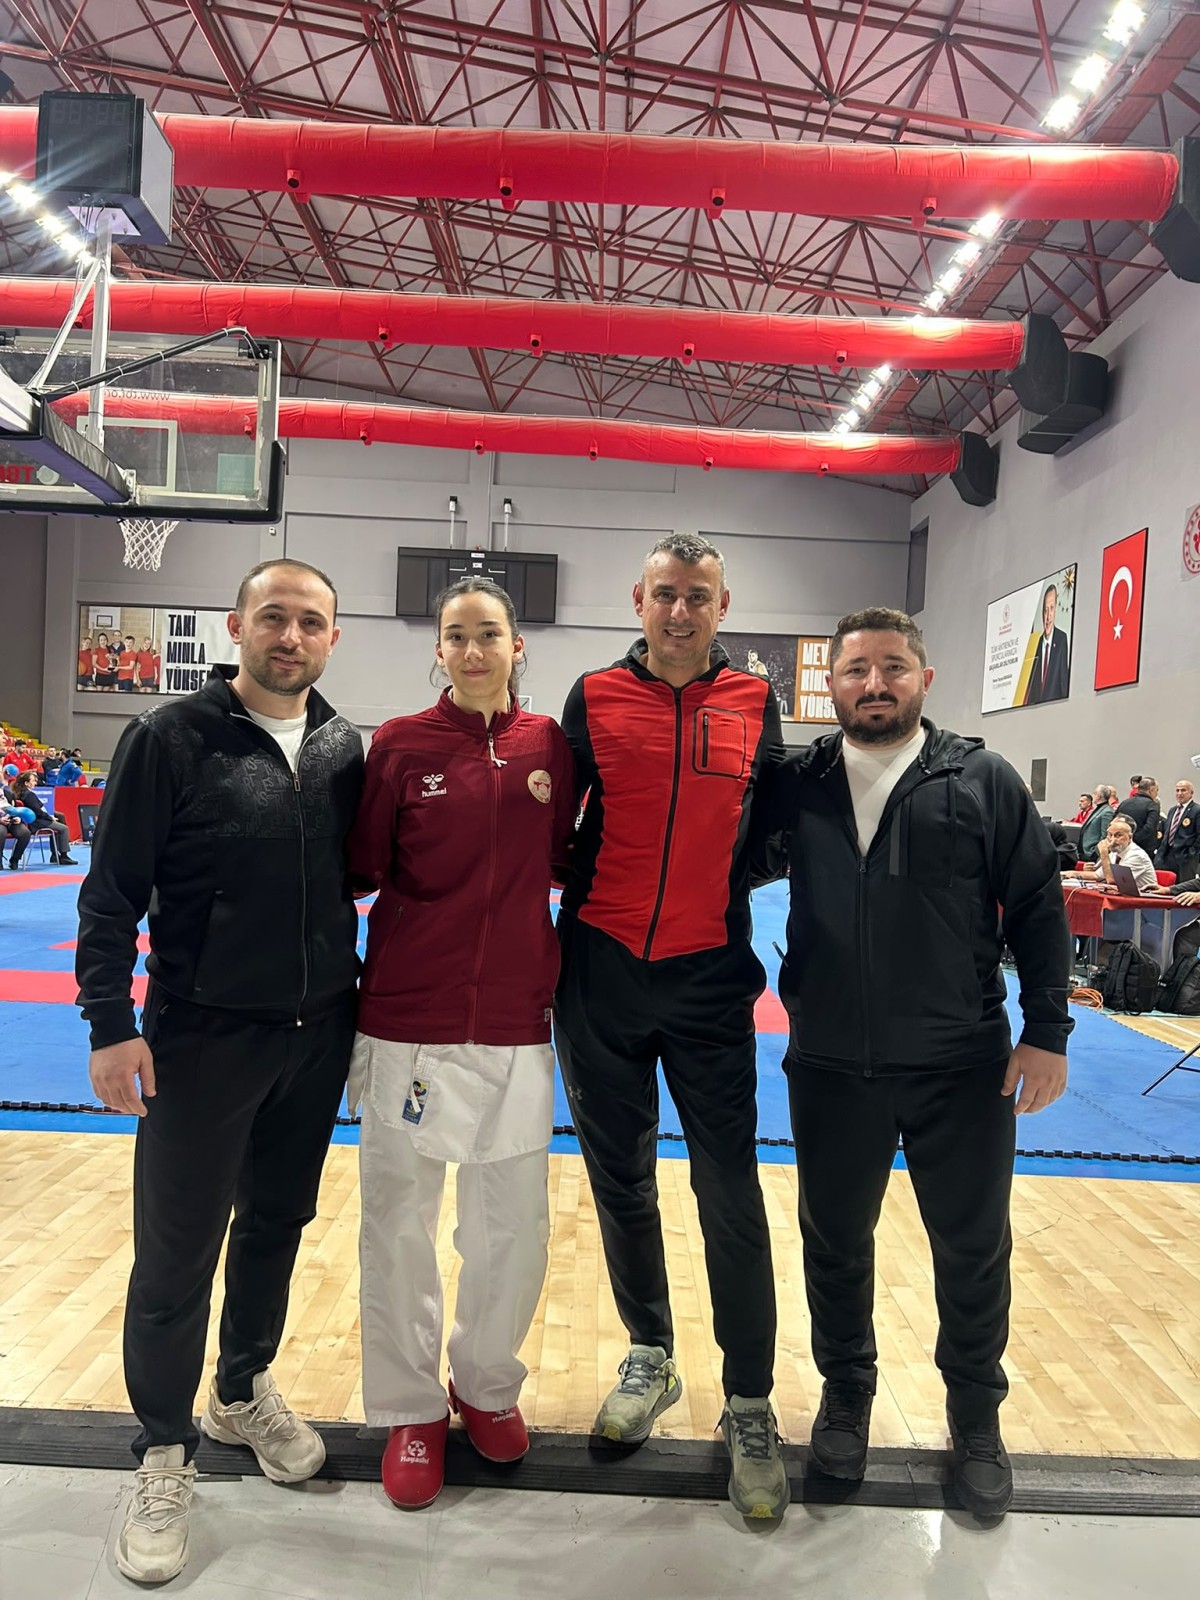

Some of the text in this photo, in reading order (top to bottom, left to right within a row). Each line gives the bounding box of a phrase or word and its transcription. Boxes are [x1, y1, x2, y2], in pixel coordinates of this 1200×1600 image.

[166, 641, 206, 665] MINLA
[802, 642, 830, 666] MEV
[421, 787, 447, 798] hummel
[400, 1455, 430, 1465] Hayashi
